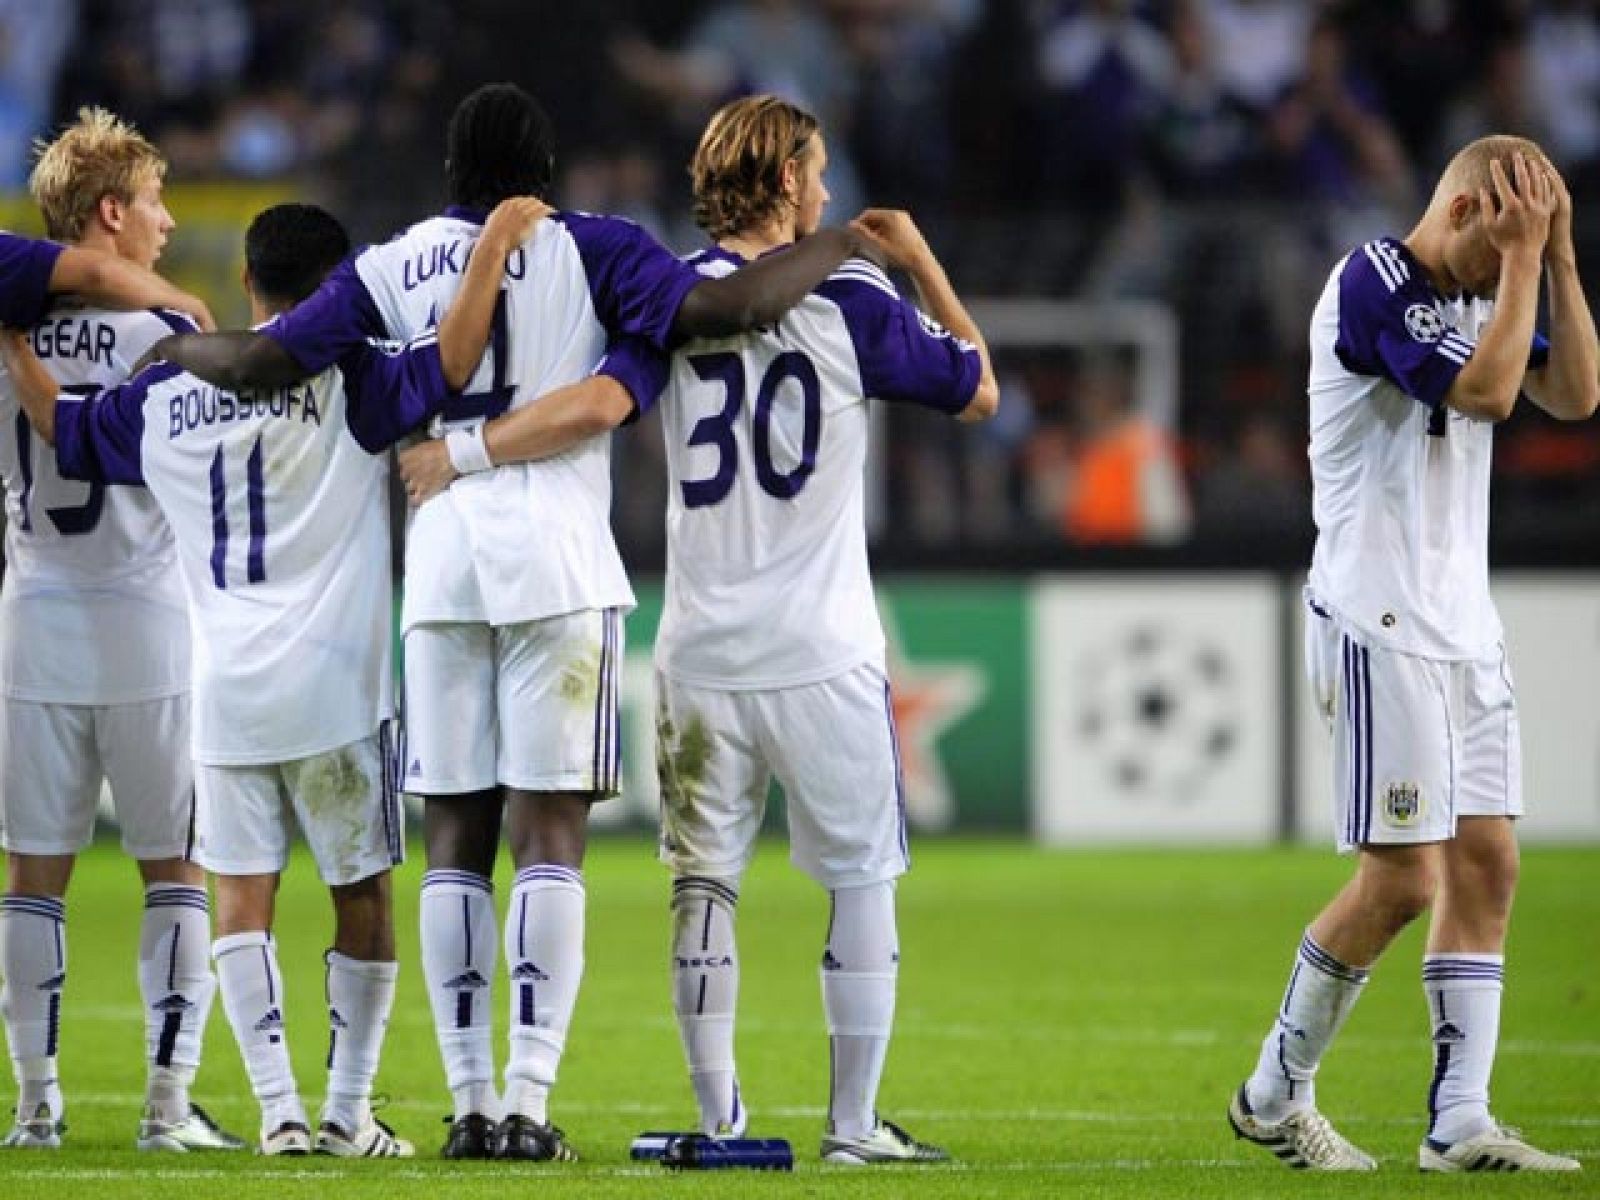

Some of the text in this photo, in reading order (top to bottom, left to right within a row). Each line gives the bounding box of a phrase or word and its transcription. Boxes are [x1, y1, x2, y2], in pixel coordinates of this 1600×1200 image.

[403, 239, 526, 292] LUKU
[26, 318, 117, 368] GEAR
[681, 351, 822, 509] 30
[209, 431, 267, 591] 11
